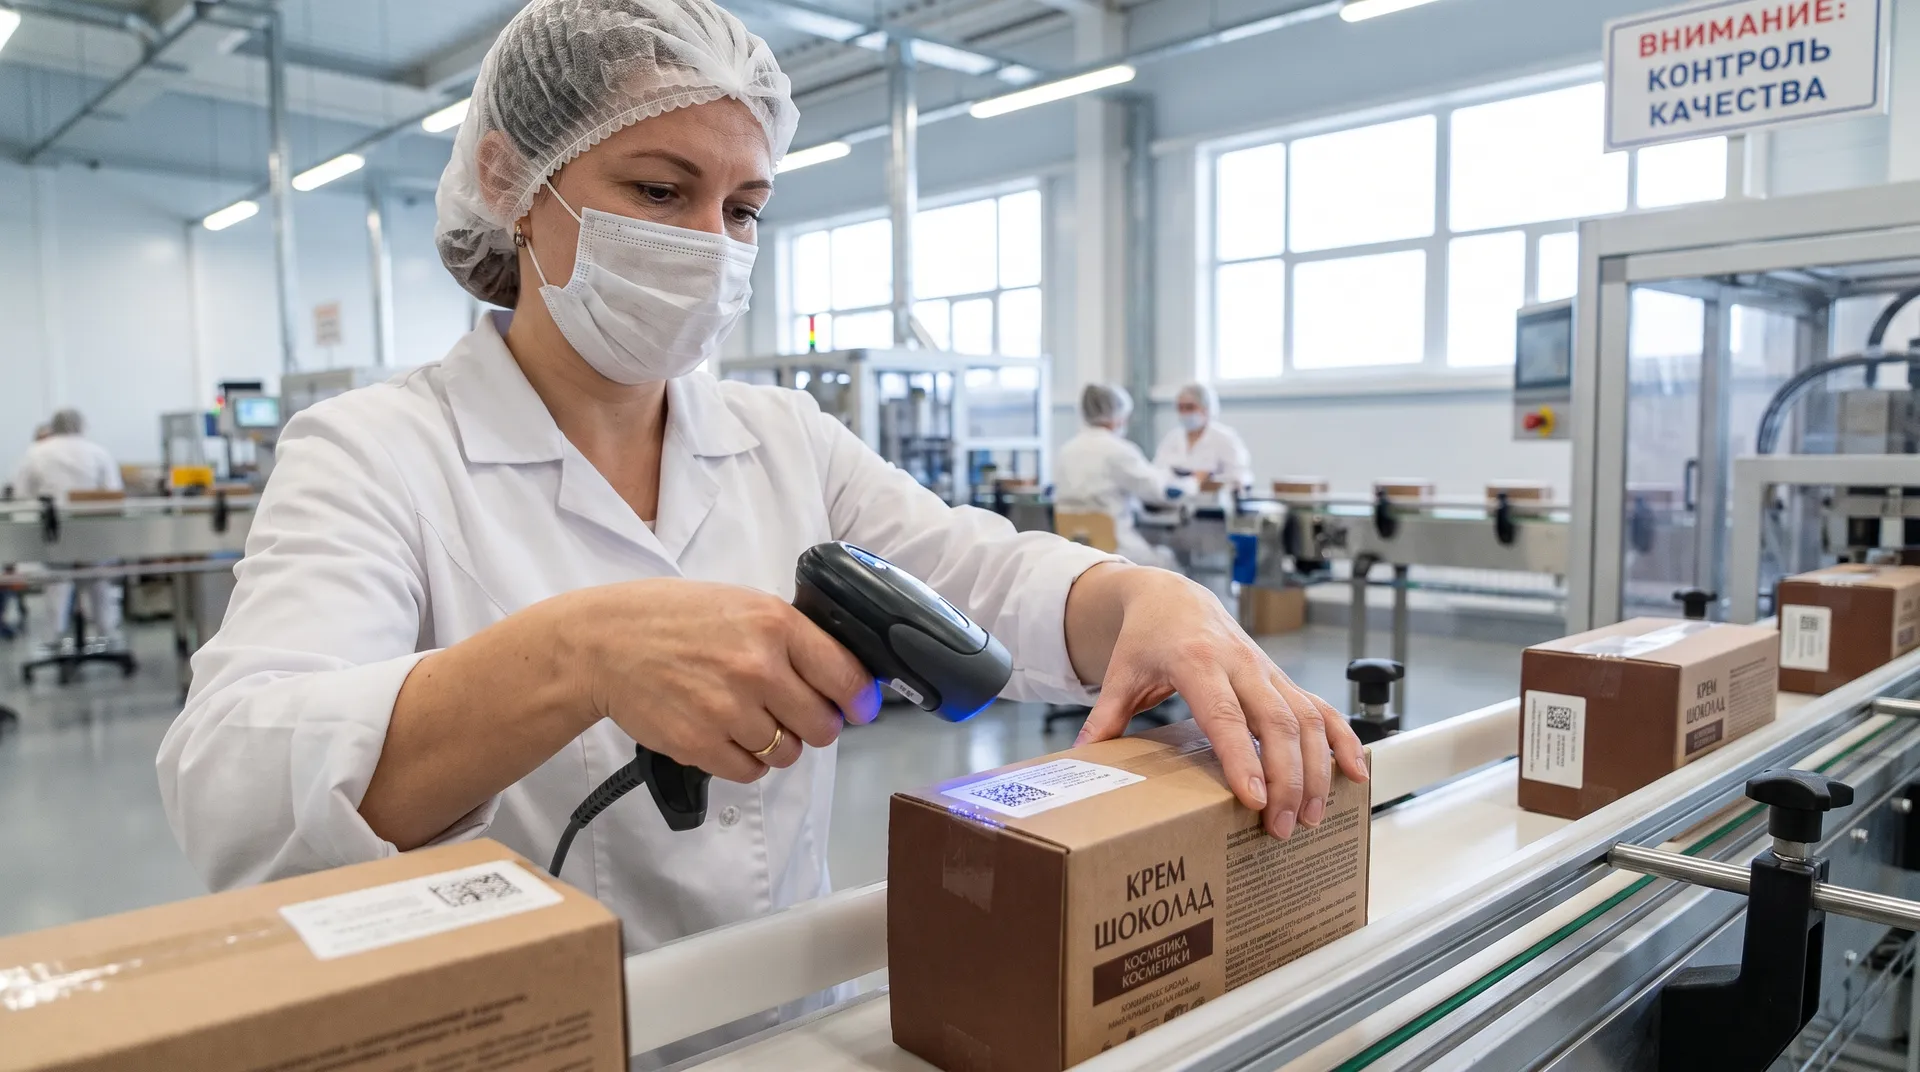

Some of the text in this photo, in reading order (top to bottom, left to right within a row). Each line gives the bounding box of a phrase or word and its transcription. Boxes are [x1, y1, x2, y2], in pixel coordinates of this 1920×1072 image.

[1639, 0, 1846, 58] ВНИМАНИЕ:
[1648, 38, 1831, 92] КОНТРОЛЬ
[1650, 76, 1826, 127] КАЧЕСТВА
[1127, 856, 1186, 902] КРЕМ
[1095, 882, 1215, 951] ШОКОЛАД
[1124, 935, 1188, 973] КОСМЕТИКА
